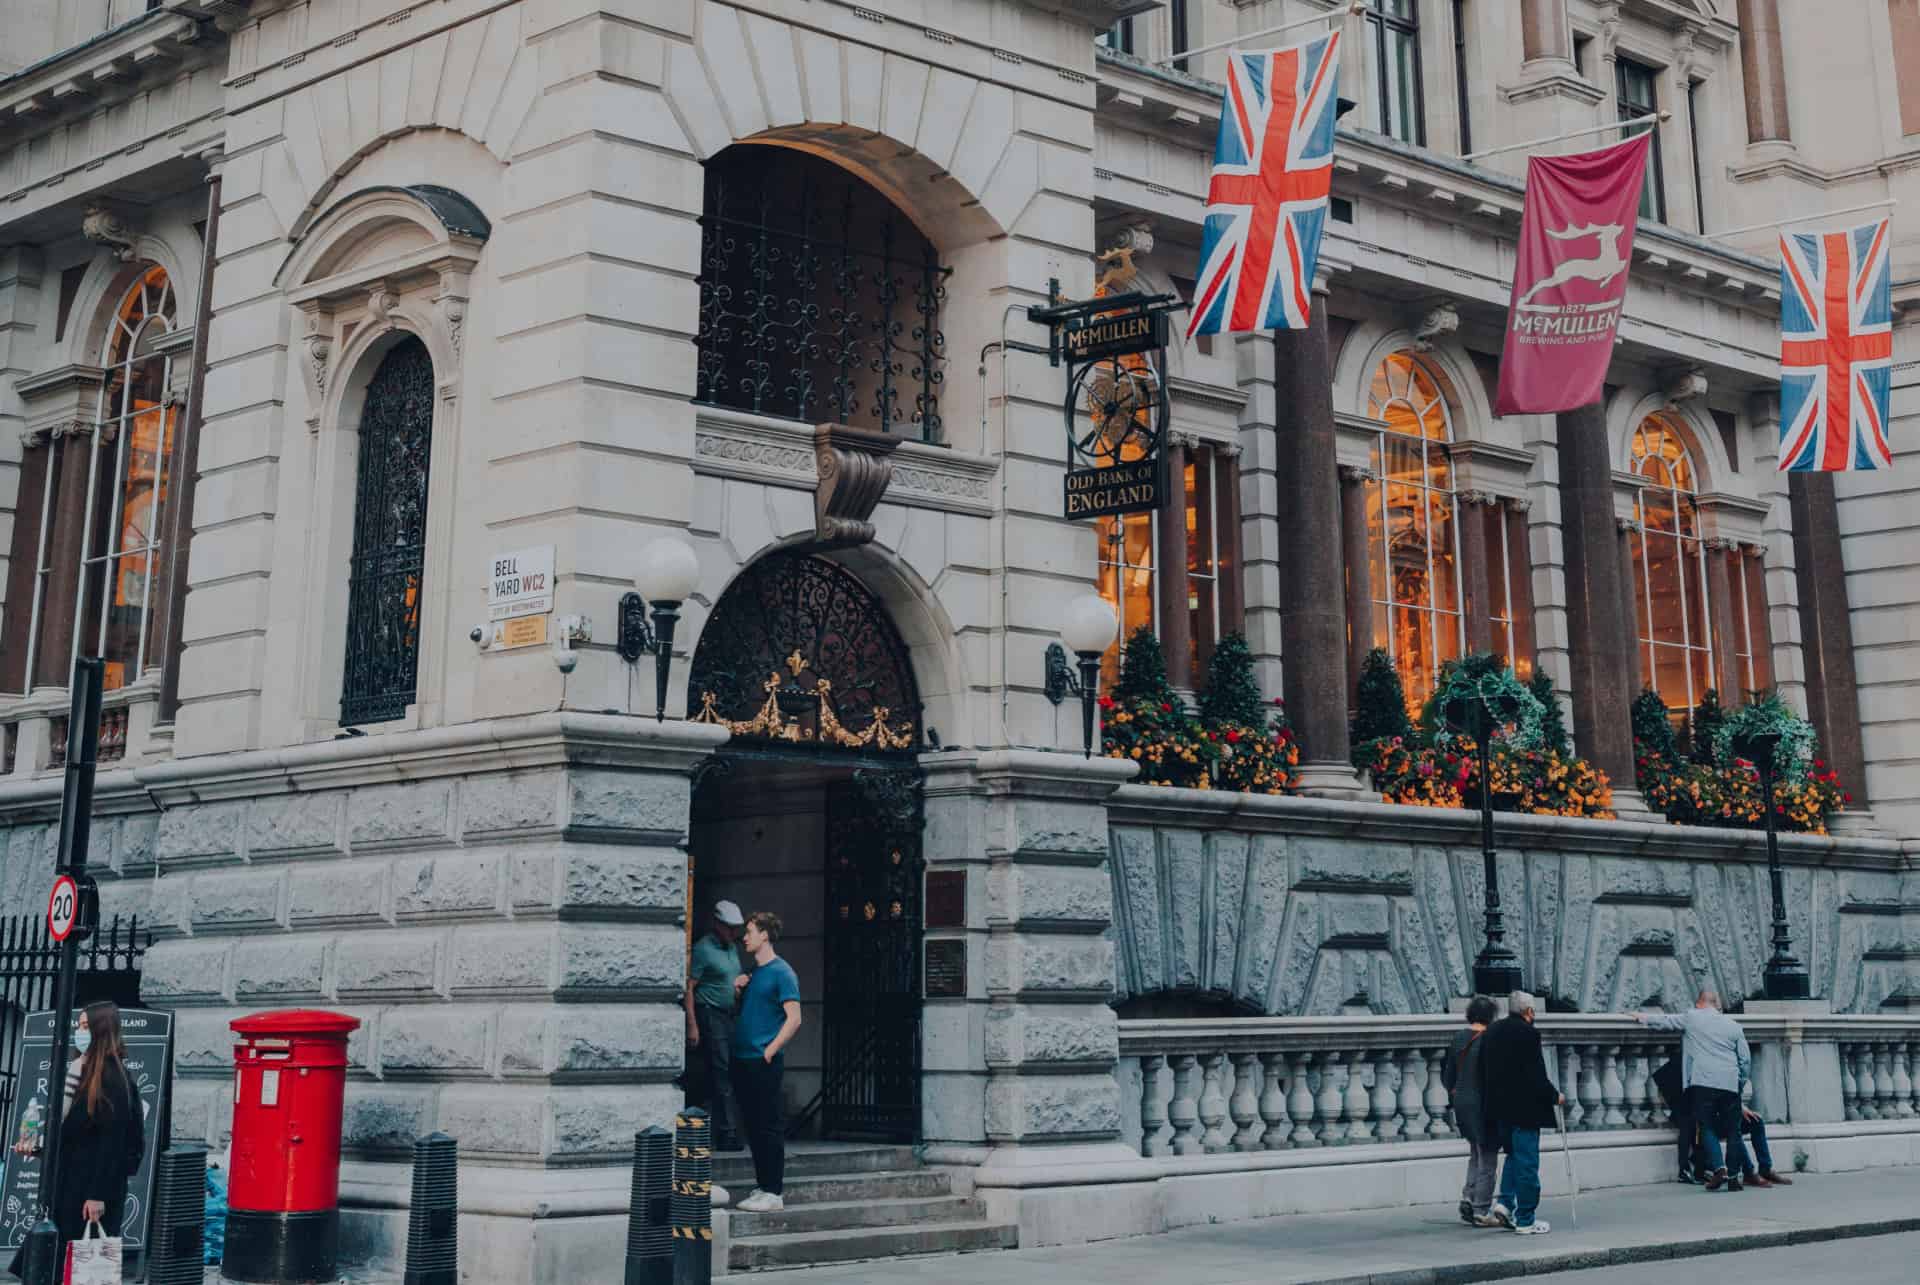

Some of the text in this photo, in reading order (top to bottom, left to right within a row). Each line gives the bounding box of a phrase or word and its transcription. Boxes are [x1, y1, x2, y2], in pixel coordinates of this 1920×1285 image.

[1561, 303, 1586, 314] 1827
[1567, 335, 1586, 345] AND
[1067, 475, 1093, 490] OLD
[1098, 469, 1133, 486] BANK
[1067, 484, 1154, 513] ENGLAND
[495, 557, 518, 577] BELL
[495, 574, 544, 598] YARD WC2
[53, 893, 73, 921] 20
